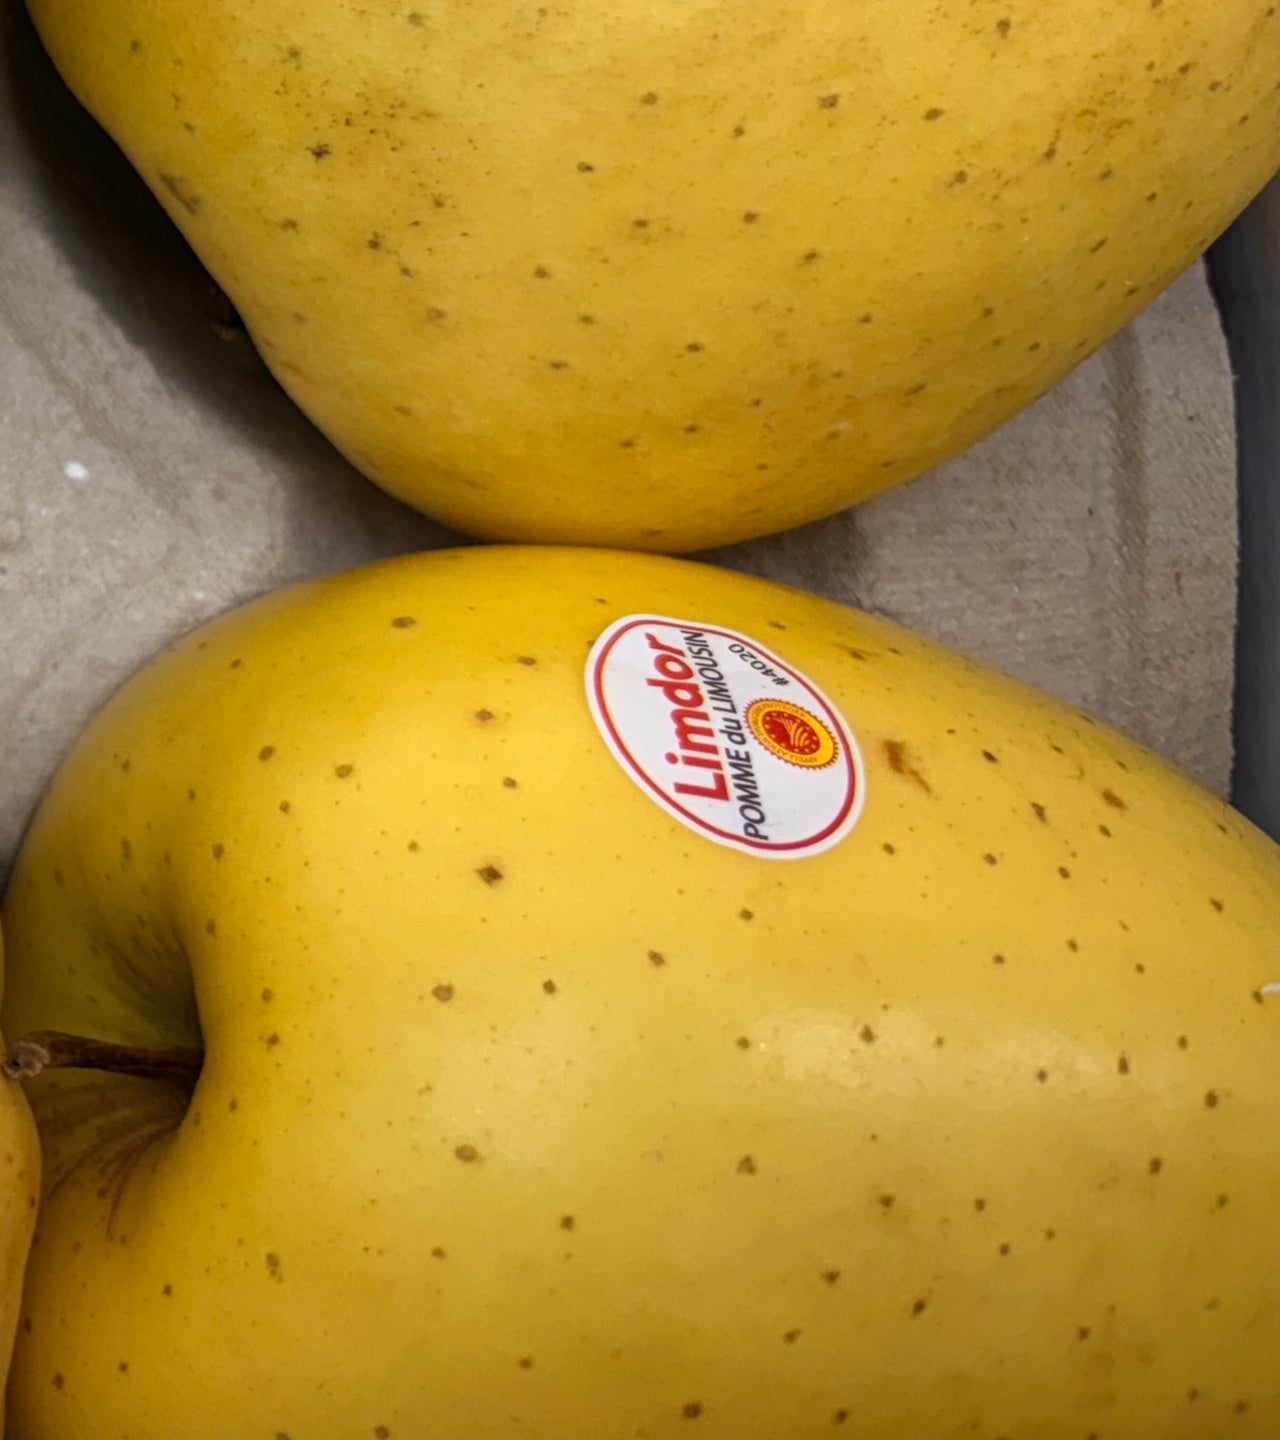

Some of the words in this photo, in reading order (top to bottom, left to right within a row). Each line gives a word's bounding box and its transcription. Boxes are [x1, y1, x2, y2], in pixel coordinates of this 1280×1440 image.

[680, 630, 737, 716] LIMOUSIN
[728, 643, 789, 687] #4020
[645, 633, 729, 801] Limdor
[719, 718, 746, 745] du
[725, 748, 768, 841] POMME
